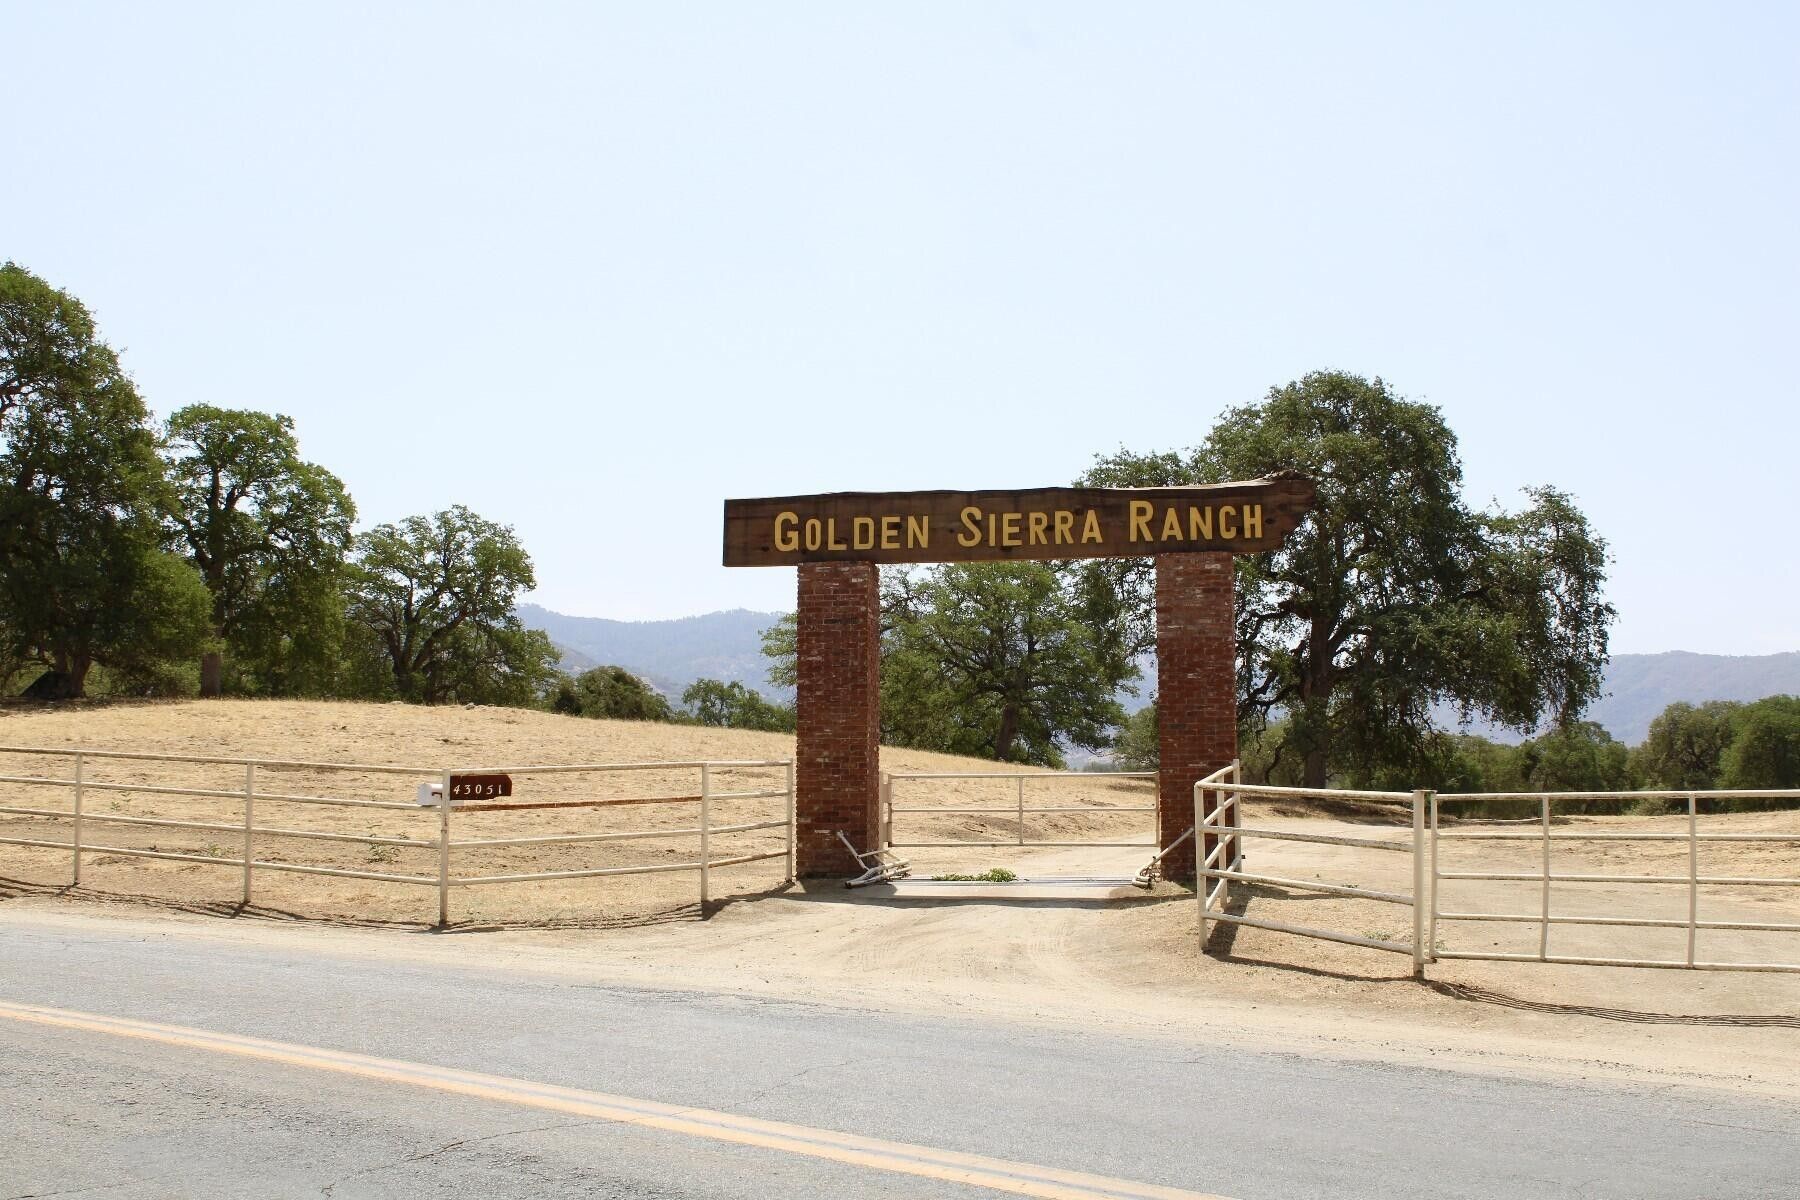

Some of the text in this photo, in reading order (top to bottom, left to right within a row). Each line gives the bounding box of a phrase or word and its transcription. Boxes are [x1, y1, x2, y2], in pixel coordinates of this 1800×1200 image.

[773, 500, 1263, 552] GOLDEN SIERRA RANCH
[453, 784, 502, 795] 43051
